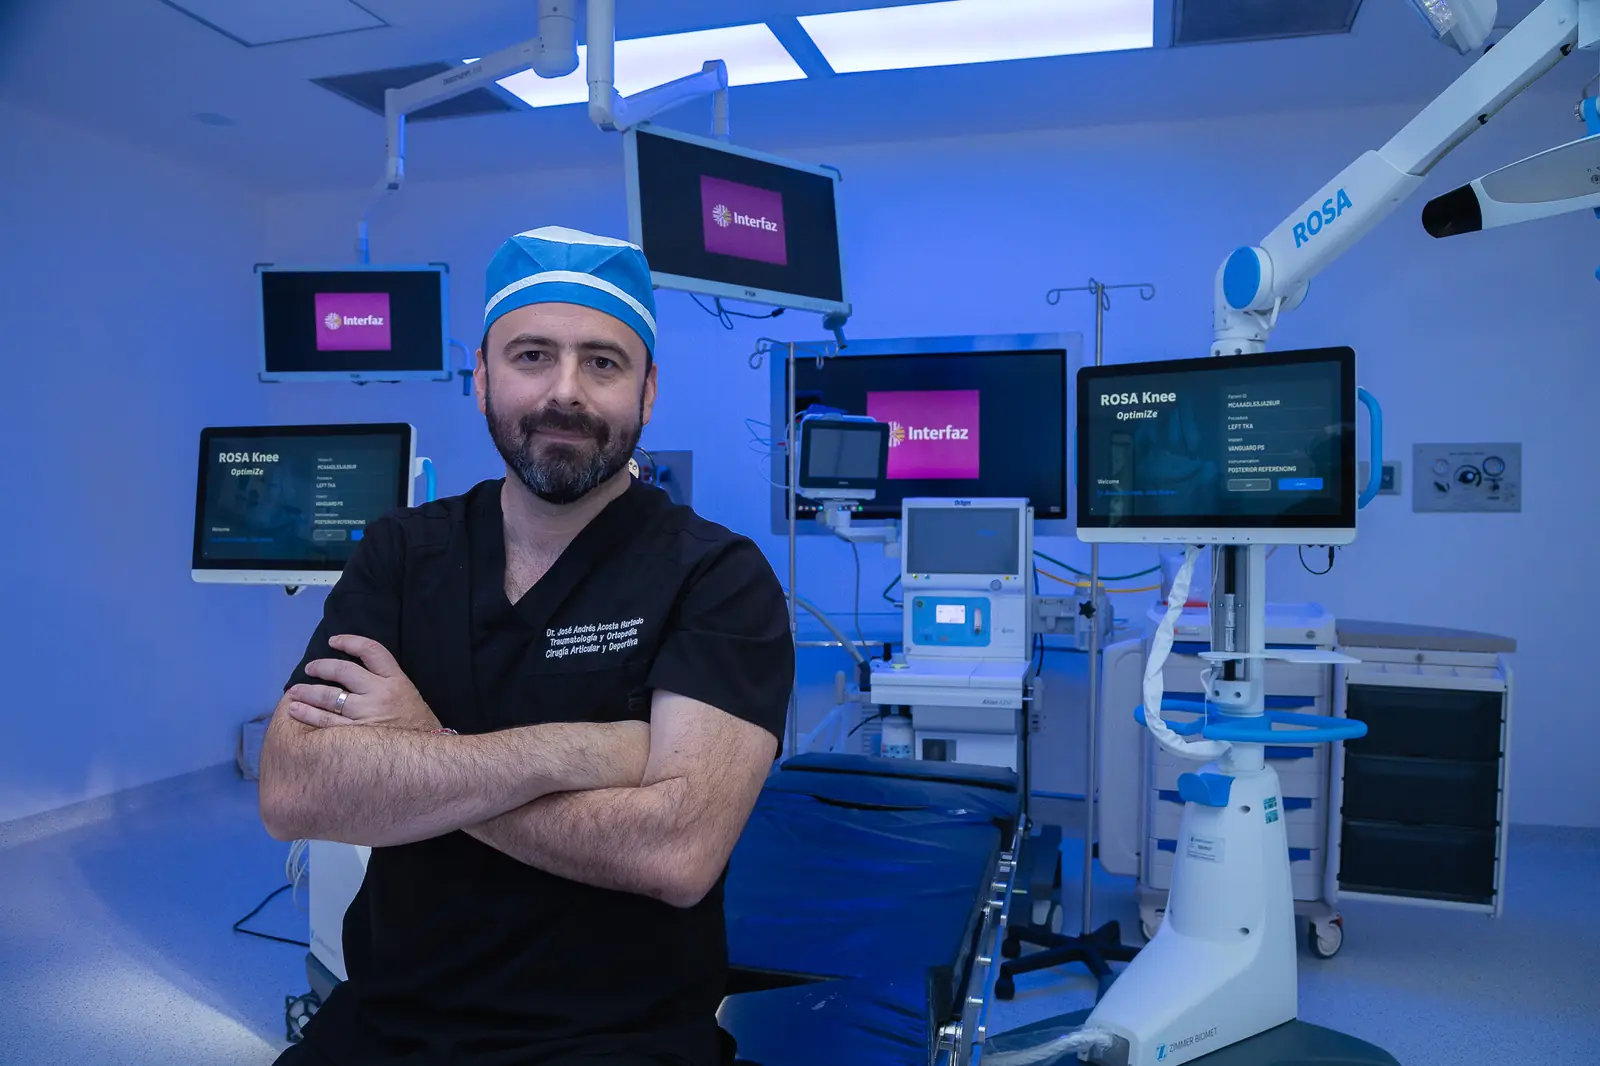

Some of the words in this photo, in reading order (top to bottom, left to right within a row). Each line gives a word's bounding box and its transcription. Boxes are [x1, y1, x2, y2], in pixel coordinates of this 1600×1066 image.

[733, 211, 778, 232] Interfaz
[1293, 188, 1353, 249] ROSA
[343, 314, 384, 326] Interfaz
[1100, 392, 1139, 406] ROSA
[1142, 391, 1177, 404] Knee
[1116, 410, 1158, 421] OptimiZe
[908, 424, 969, 441] Interfaz
[218, 452, 250, 463] ROSA
[252, 452, 280, 463] Knee
[230, 468, 264, 476] OptimiZe
[1258, 465, 1297, 473] REFERENCING
[546, 628, 556, 637] Dr.
[557, 626, 573, 637] José
[573, 623, 596, 634] Andrés
[597, 622, 619, 632] Acosta
[620, 617, 644, 629] Hurtado
[550, 633, 598, 647] Traumatología
[600, 634, 605, 643] y
[545, 646, 569, 659] Cirugía
[570, 644, 601, 655] Articular
[602, 644, 607, 654] y
[608, 637, 639, 652] Deportiva
[1169, 1036, 1194, 1053] ZIMMER
[1194, 1027, 1217, 1043] BIOMET
